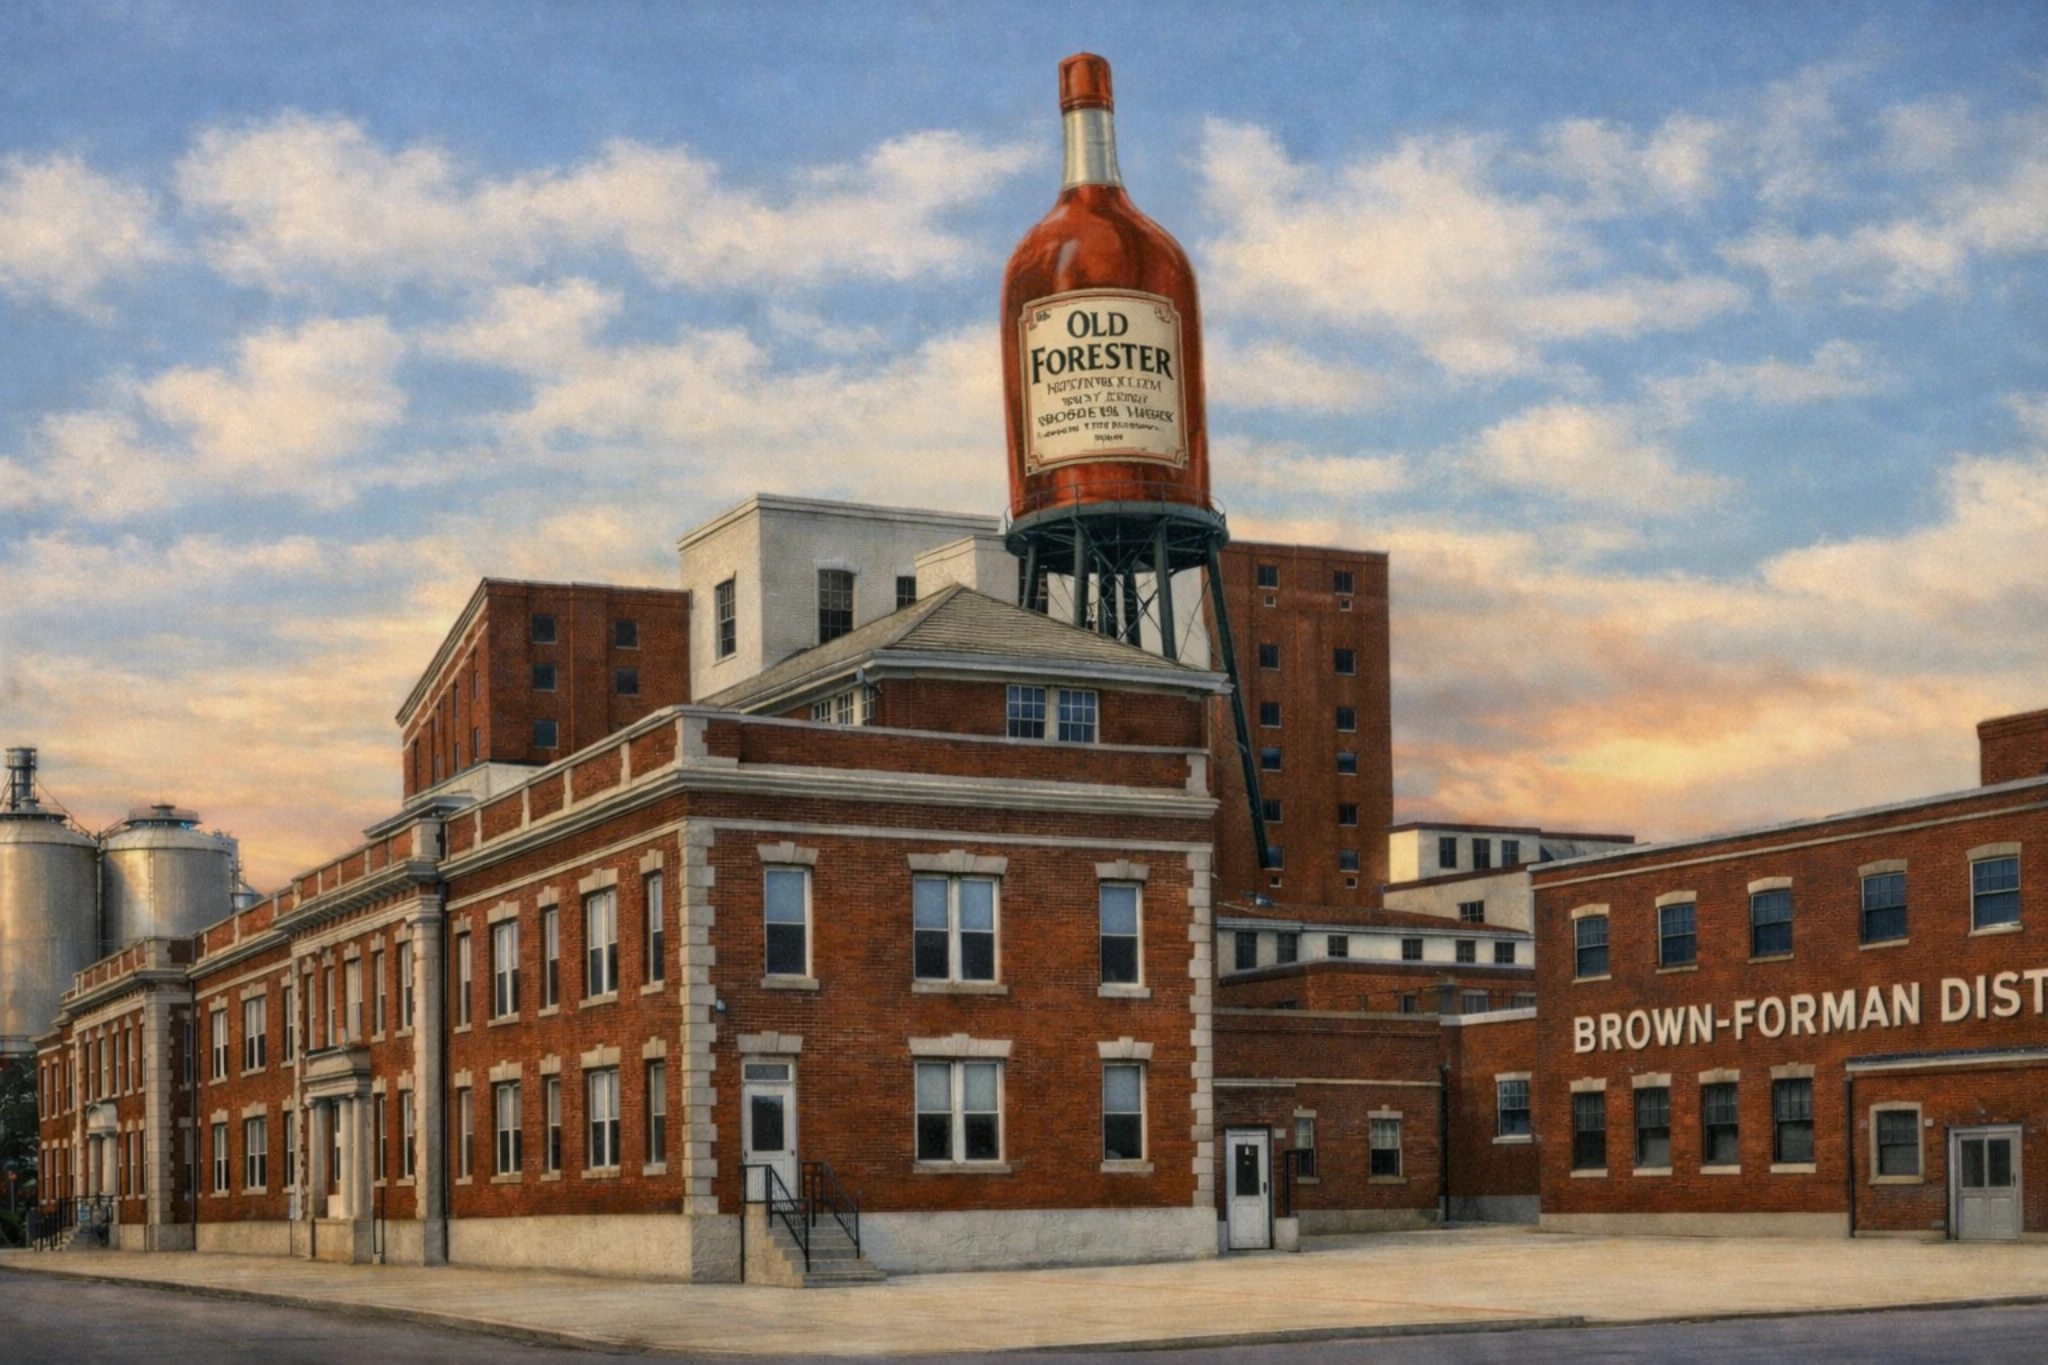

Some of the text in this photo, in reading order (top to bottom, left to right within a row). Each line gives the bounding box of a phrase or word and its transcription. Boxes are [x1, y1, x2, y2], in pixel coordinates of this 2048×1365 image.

[1066, 310, 1129, 339] OLD
[1031, 342, 1174, 385] FORESTER
[1573, 968, 2048, 1054] BROWN-FORMAN DIST
